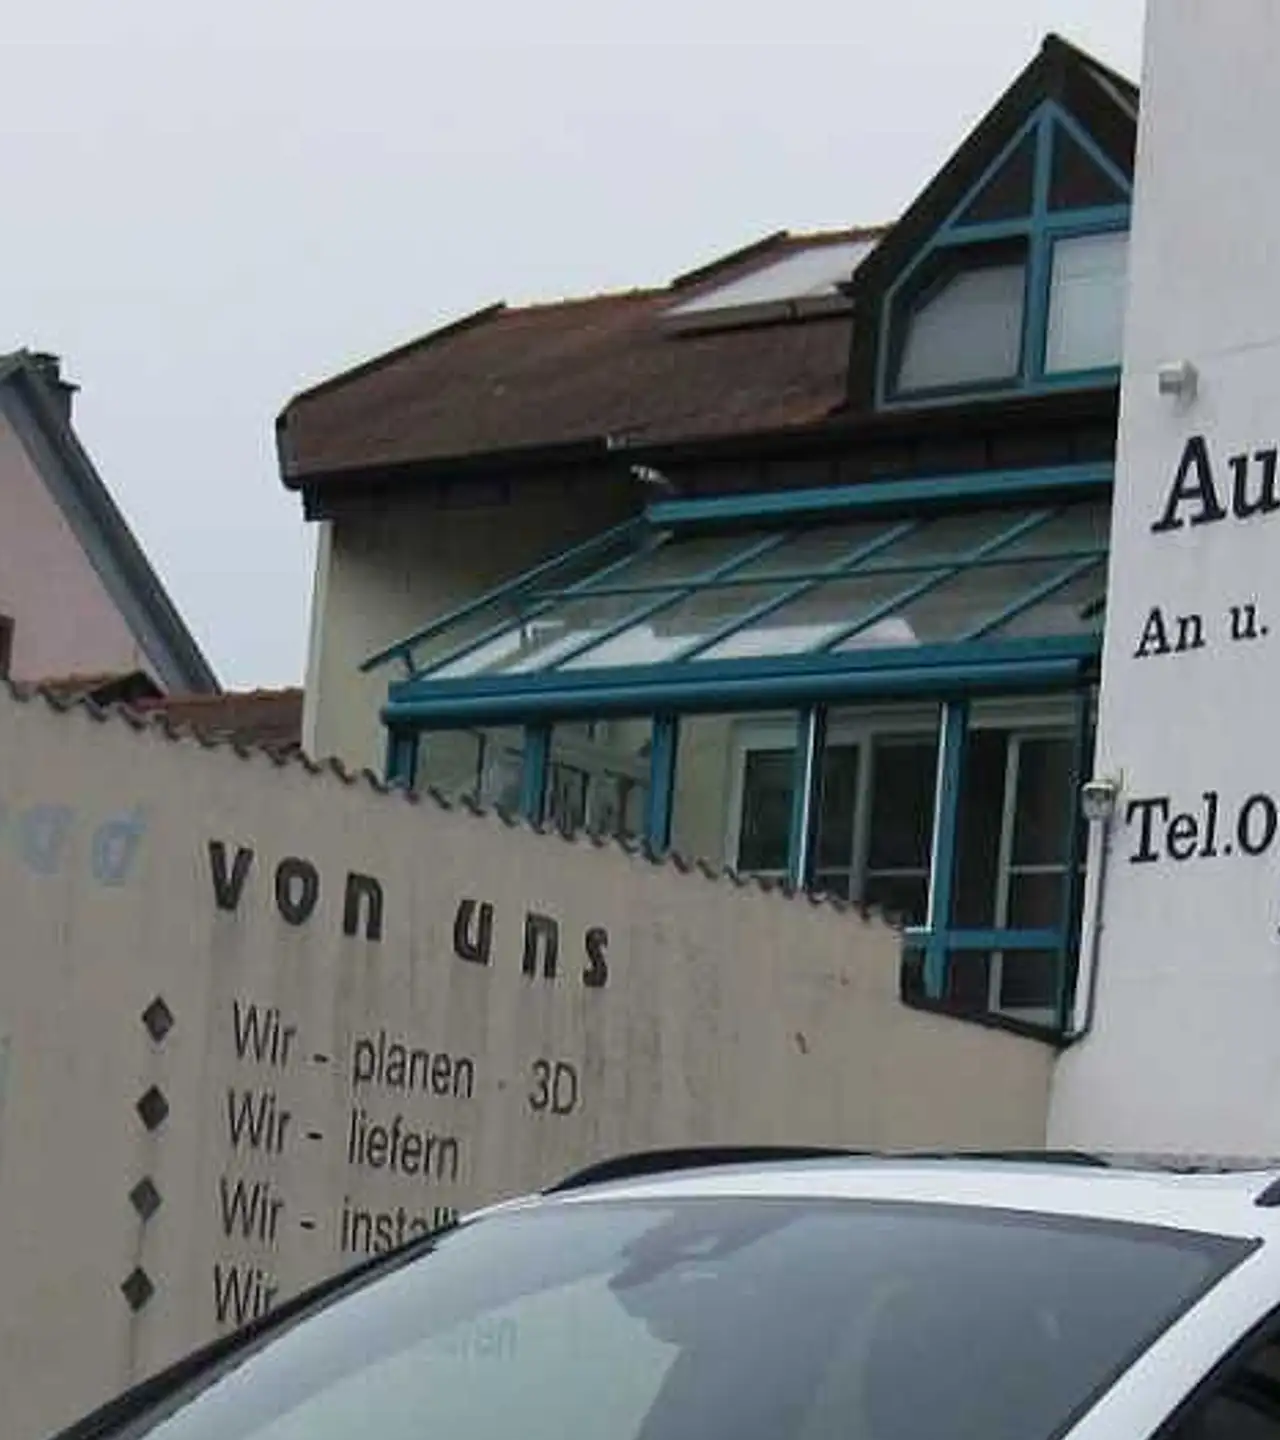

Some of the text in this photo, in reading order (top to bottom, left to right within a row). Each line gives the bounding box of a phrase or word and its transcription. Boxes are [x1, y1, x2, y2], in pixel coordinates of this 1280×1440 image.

[1134, 607, 1206, 658] An
[1229, 603, 1269, 640] u.
[207, 841, 384, 942] von
[453, 899, 609, 988] uns
[232, 1000, 297, 1069] Wir
[352, 1032, 475, 1099] planen
[528, 1060, 579, 1116] 3D
[227, 1089, 291, 1155] Wir
[348, 1109, 459, 1180] liefern
[220, 1177, 284, 1241] Wir
